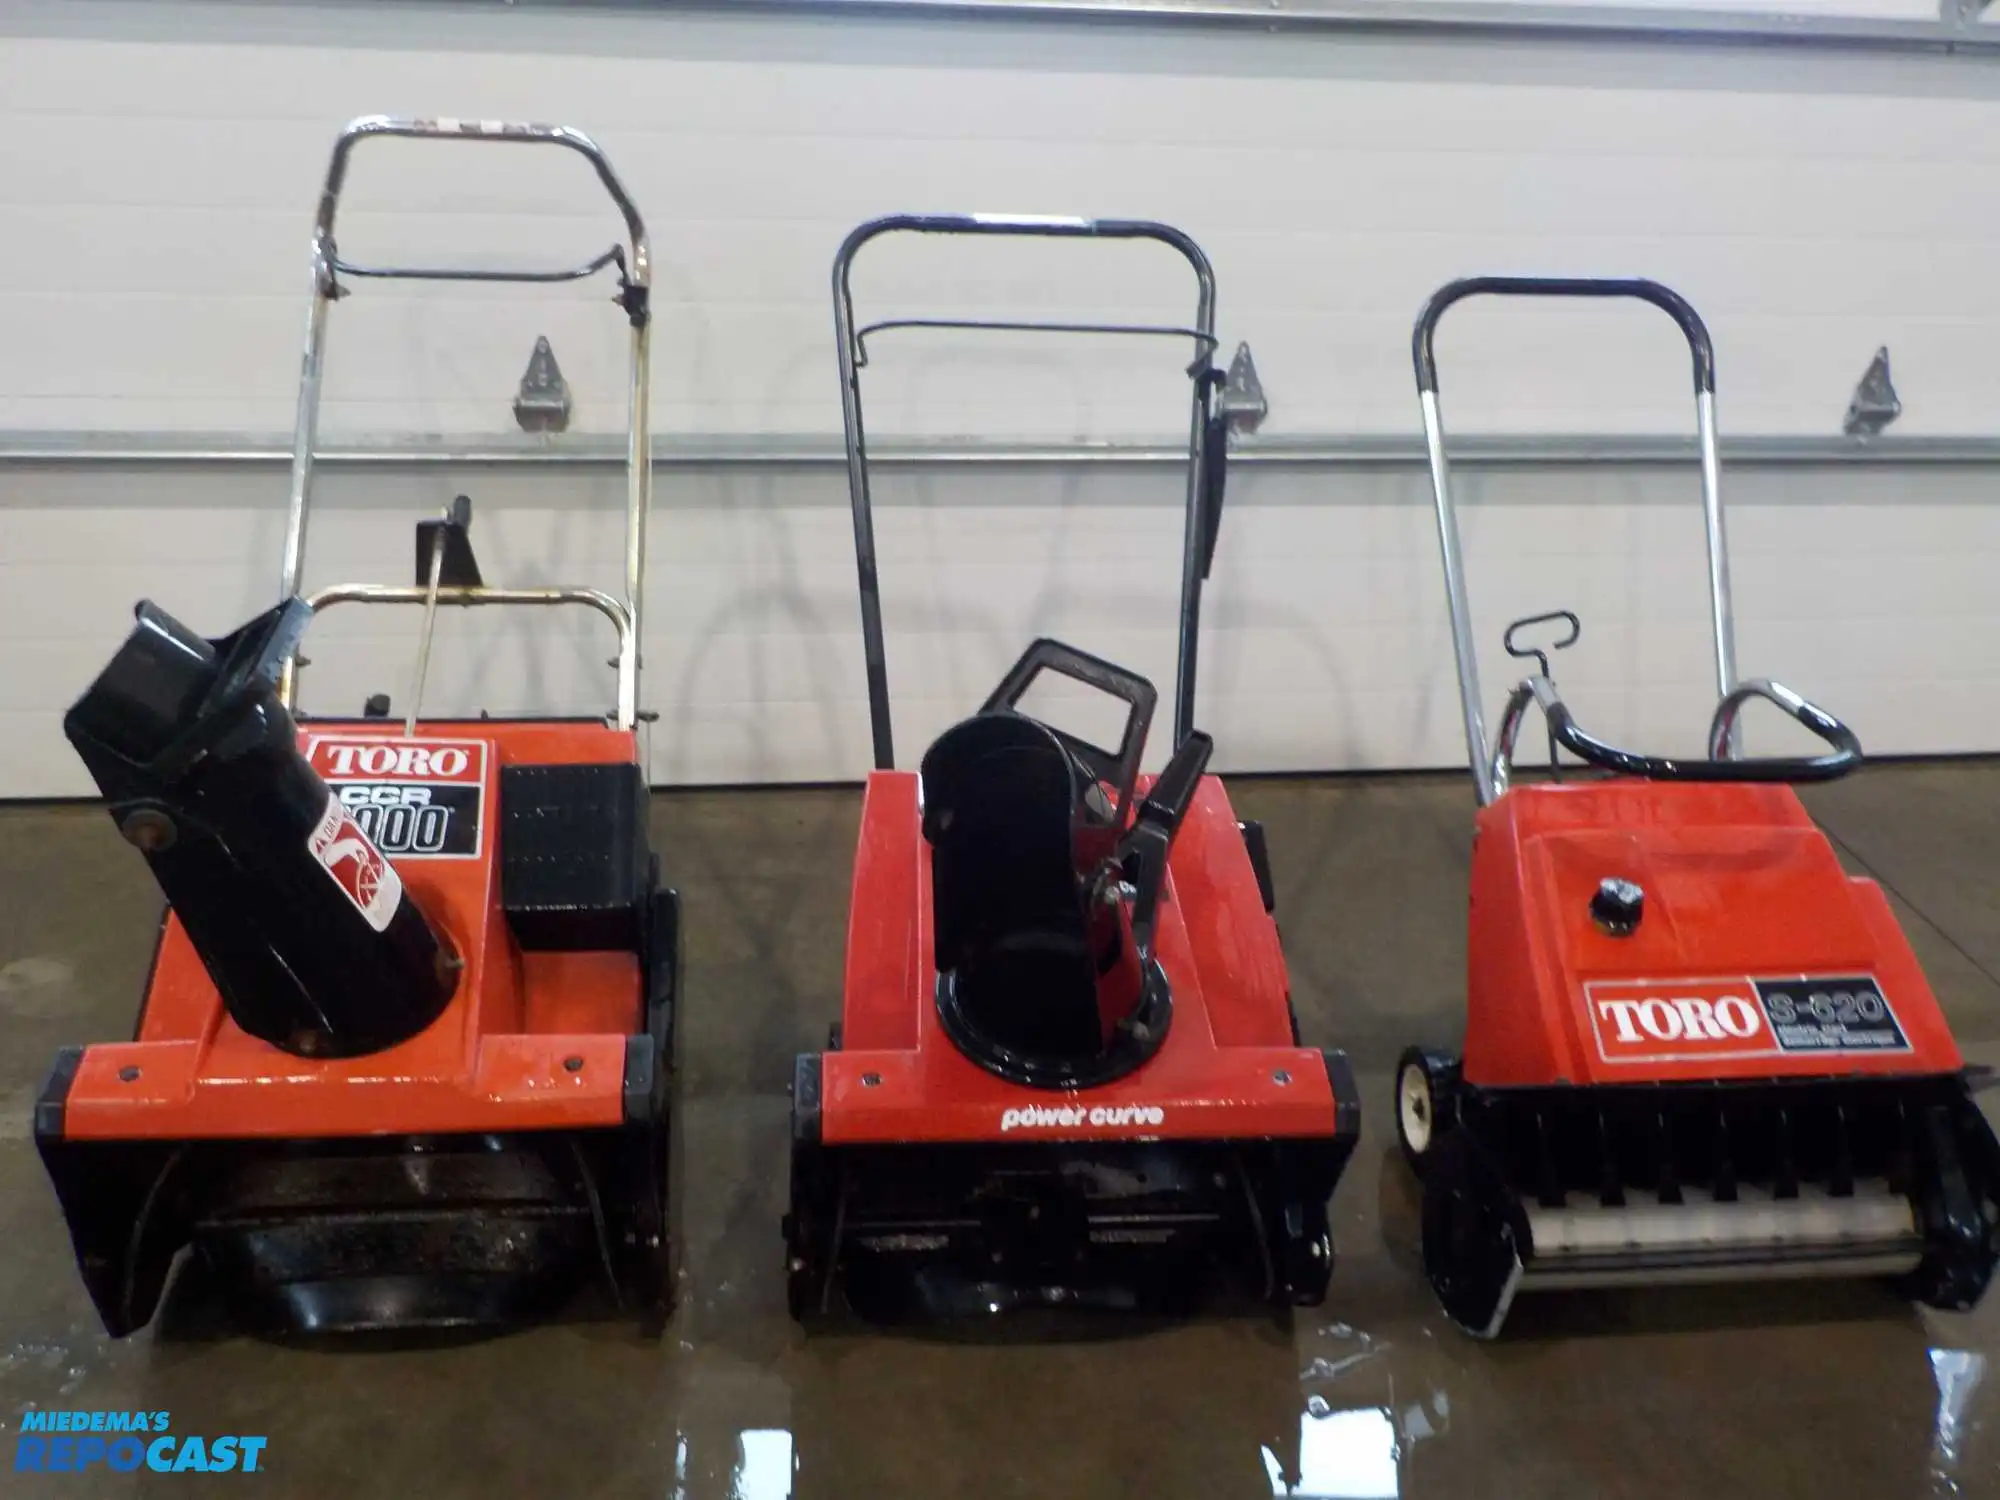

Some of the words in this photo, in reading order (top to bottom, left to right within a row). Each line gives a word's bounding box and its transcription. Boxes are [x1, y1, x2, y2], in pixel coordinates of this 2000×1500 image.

[328, 745, 468, 777] TORO
[339, 786, 432, 805] CCR
[344, 804, 449, 851] 000
[1600, 996, 1760, 1042] TORO
[1767, 991, 1885, 1024] S-620
[1001, 1105, 1087, 1131] power
[1089, 1106, 1164, 1126] curve
